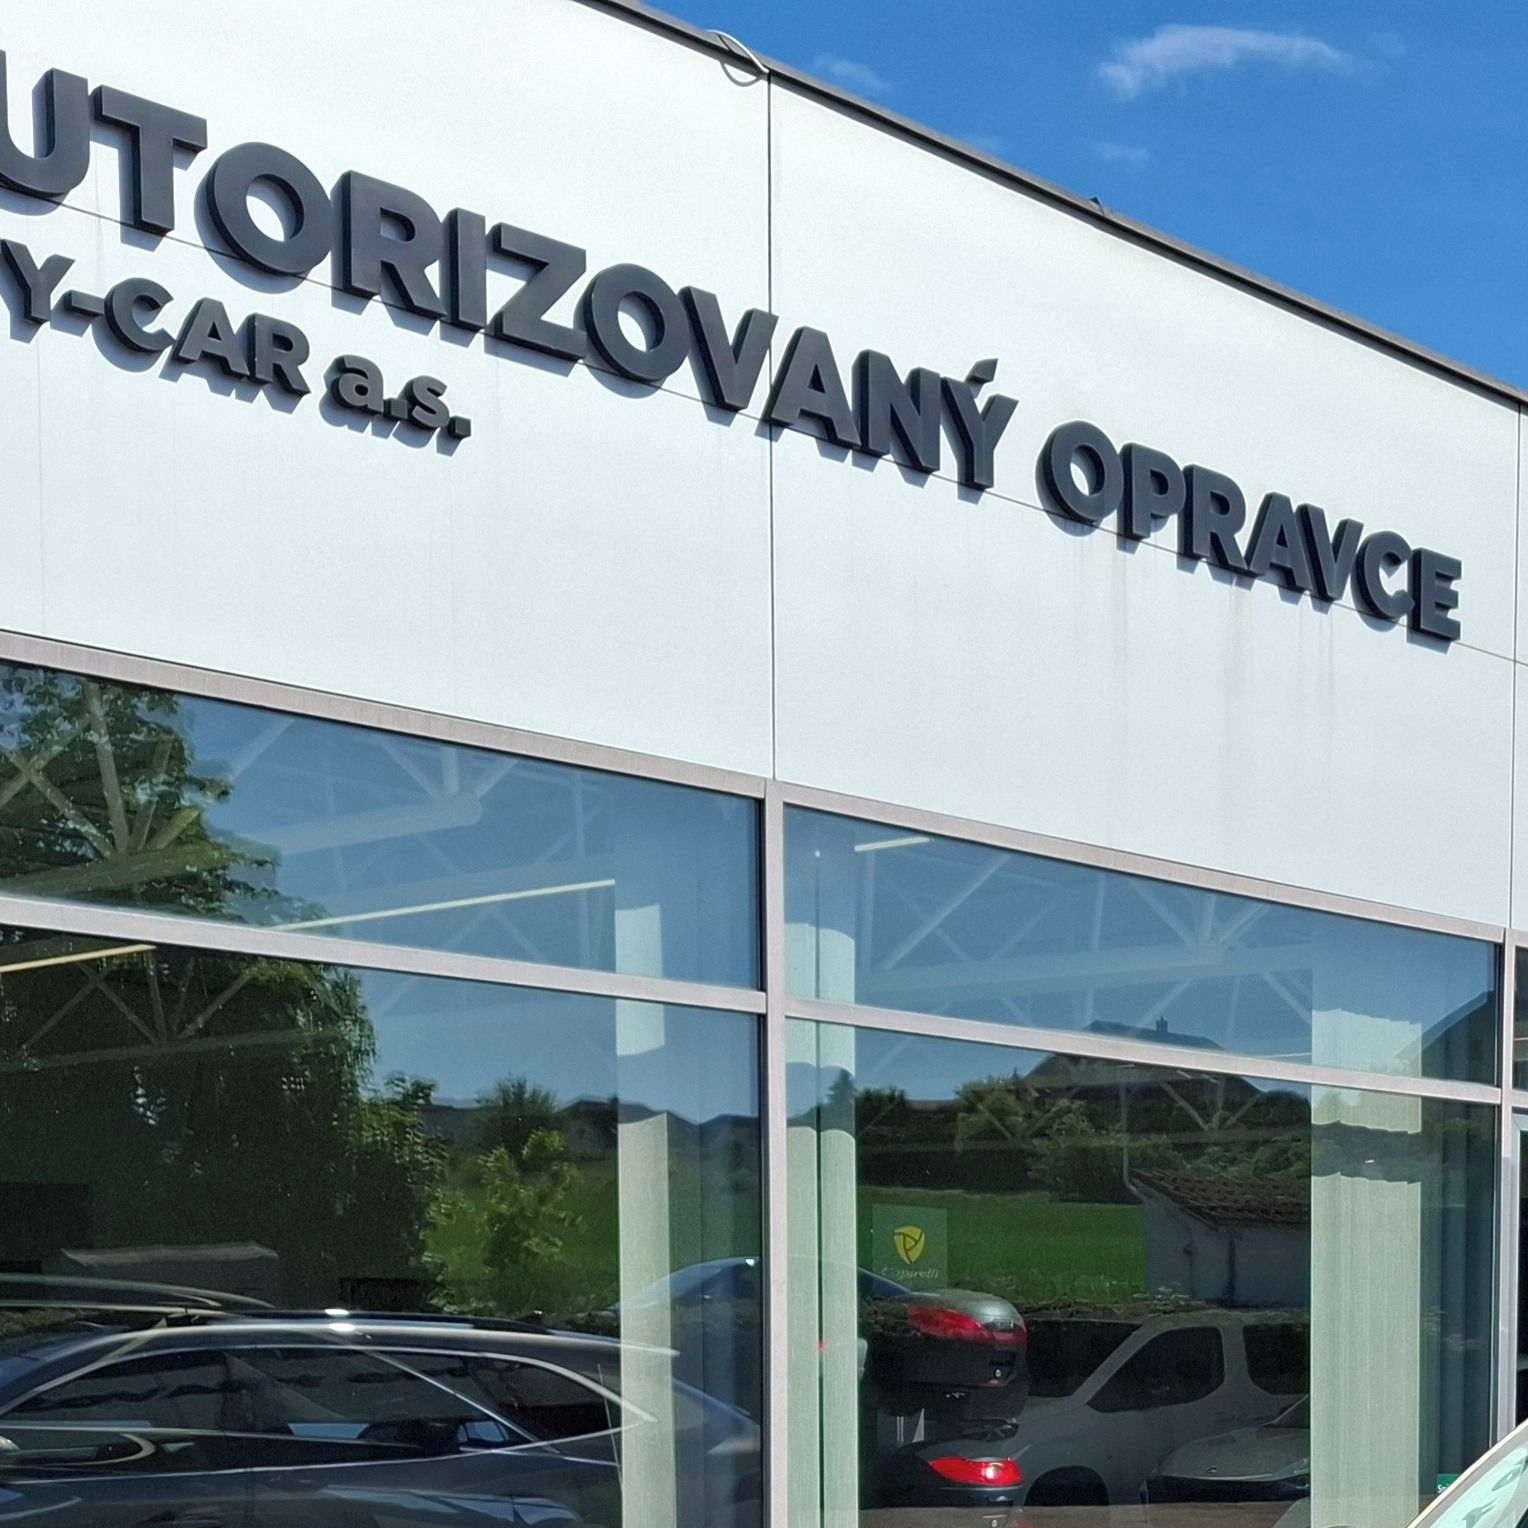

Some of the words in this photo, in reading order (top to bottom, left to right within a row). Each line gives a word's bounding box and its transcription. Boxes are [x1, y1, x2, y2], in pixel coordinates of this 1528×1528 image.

[0, 50, 1019, 490] UTORIZOVANÝ
[1040, 420, 1462, 642] OPRAVCE
[332, 355, 472, 440] a.s.
